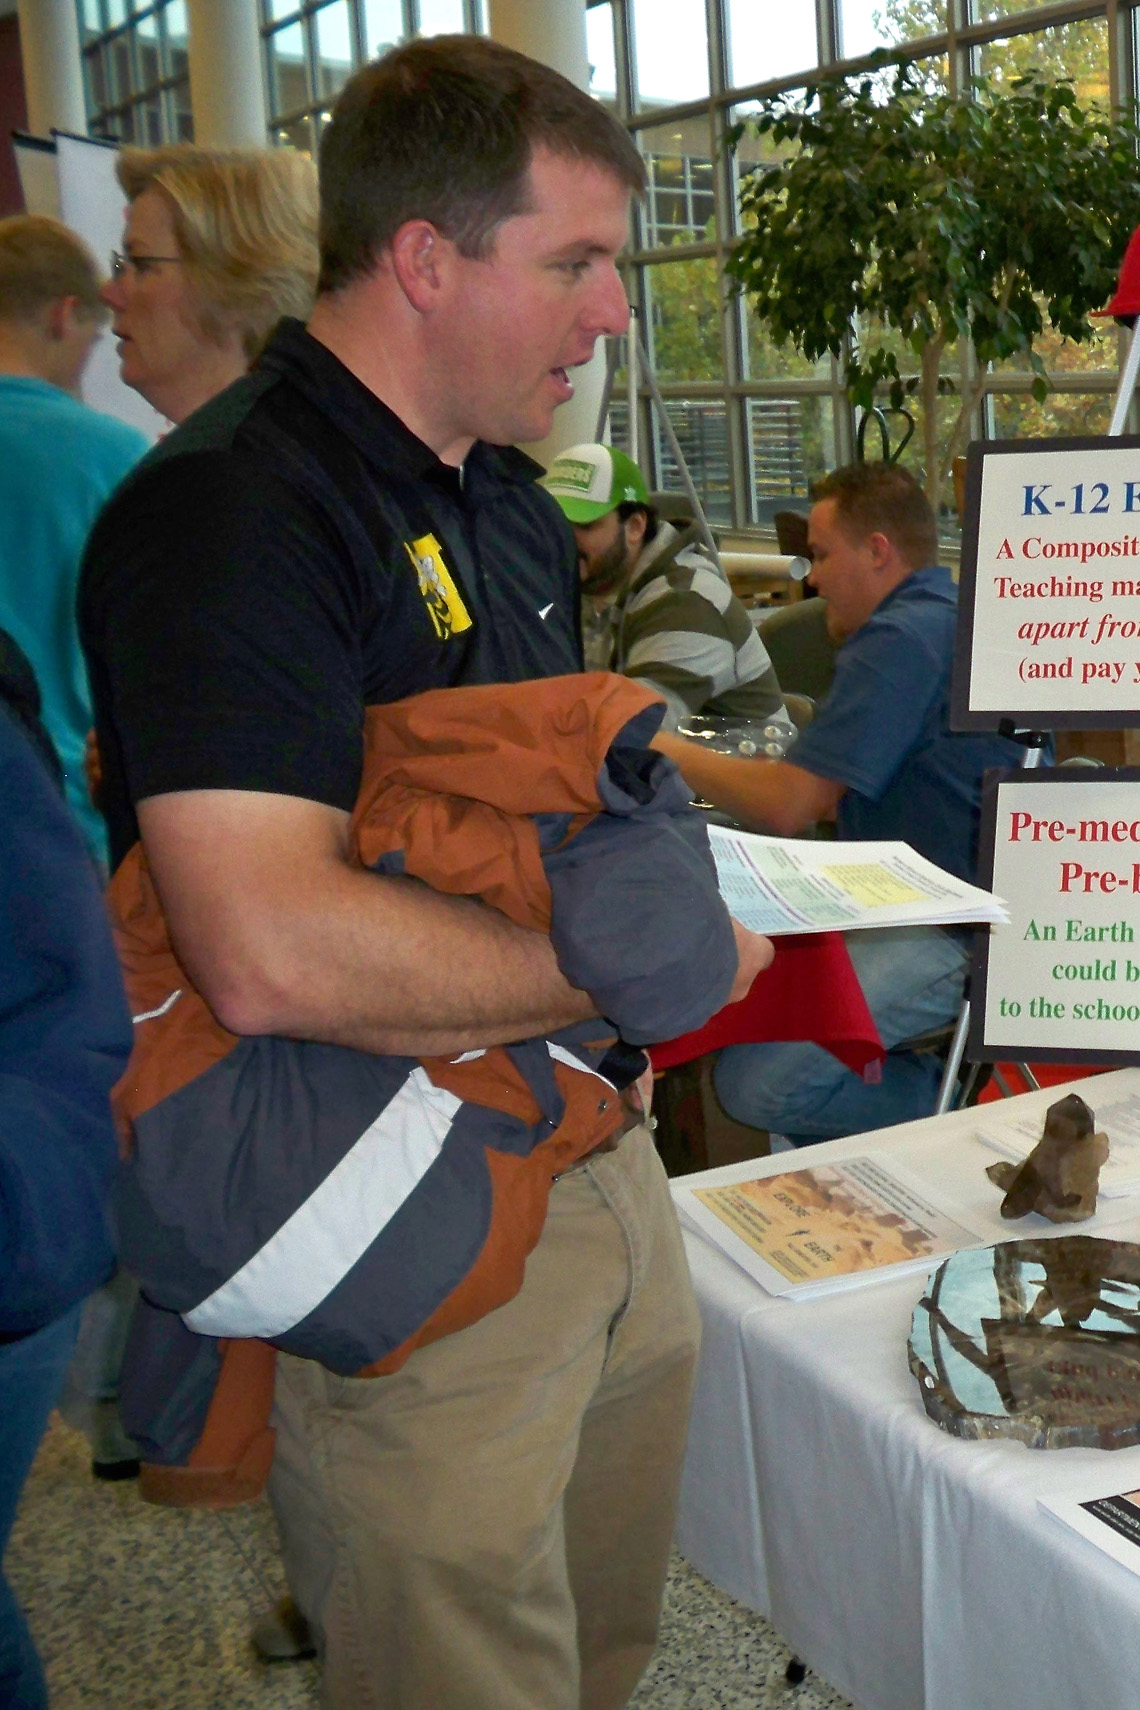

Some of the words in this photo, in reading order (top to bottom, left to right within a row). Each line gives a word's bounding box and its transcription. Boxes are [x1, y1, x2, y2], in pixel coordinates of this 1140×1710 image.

[1021, 483, 1110, 516] K-12
[996, 538, 1014, 560] A
[994, 575, 1103, 602] Teaching
[1018, 616, 1089, 645] apart
[1018, 657, 1073, 683] (and
[1081, 659, 1124, 683] pay
[1024, 920, 1056, 941] An
[1065, 920, 1134, 943] Earth
[1052, 961, 1116, 982] could
[1000, 999, 1021, 1017] to
[1029, 997, 1065, 1019] the
